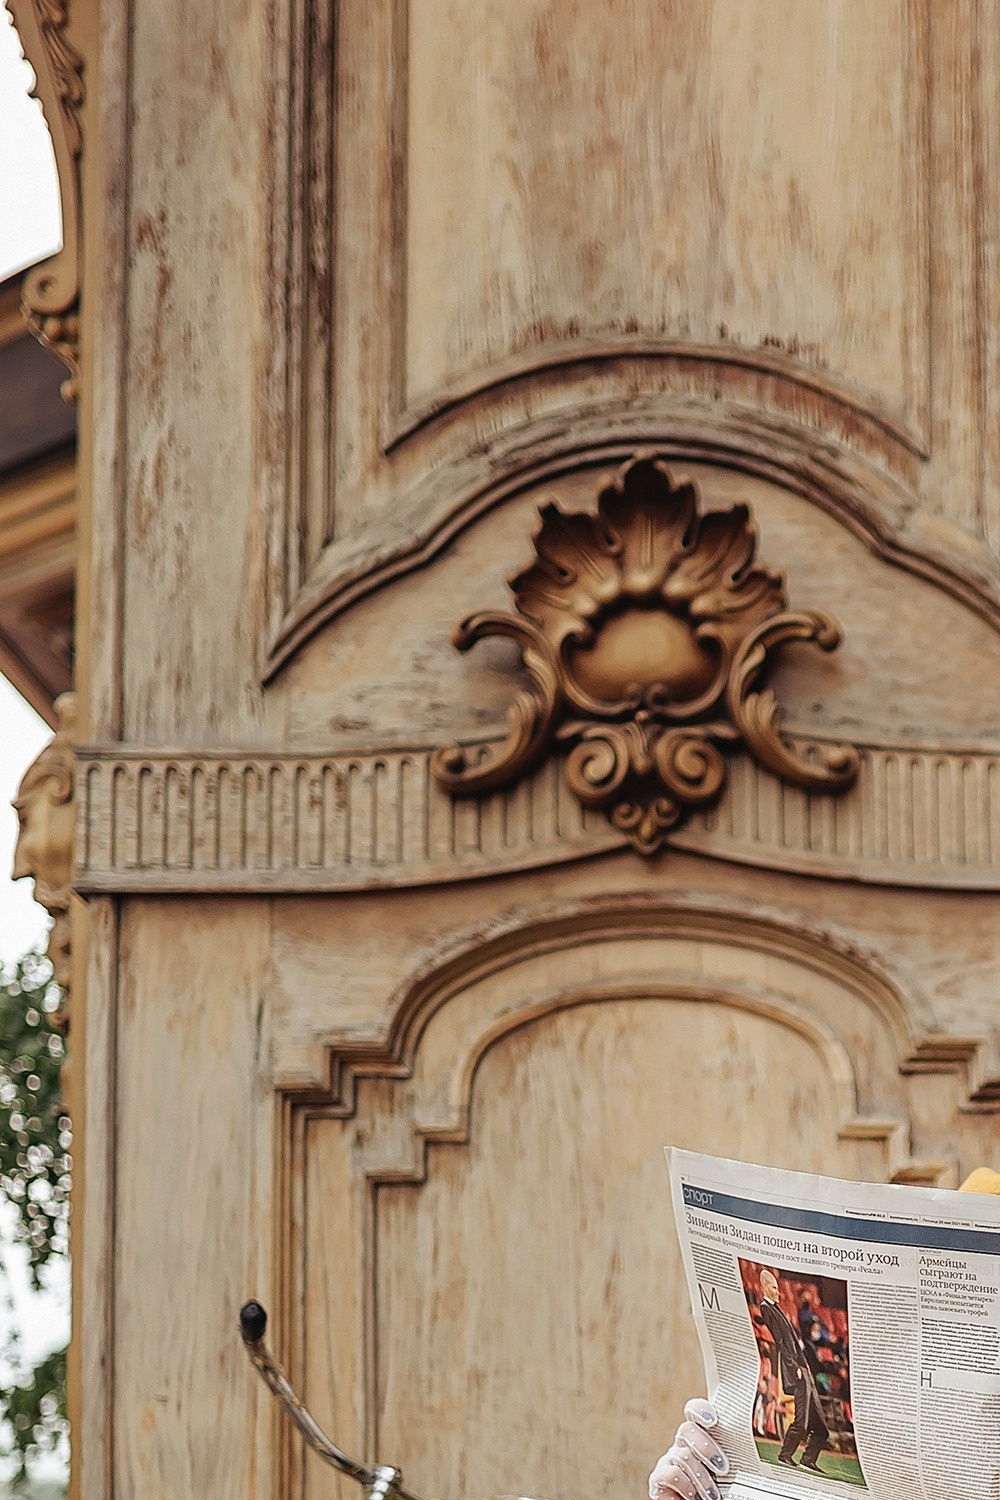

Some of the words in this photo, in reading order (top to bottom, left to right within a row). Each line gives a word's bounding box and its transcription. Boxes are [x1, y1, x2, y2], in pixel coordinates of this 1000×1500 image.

[684, 1187, 713, 1205] спорт
[686, 1212, 728, 1234] Зинедин
[729, 1224, 761, 1243] Зидан
[763, 1236, 800, 1251] пошел
[803, 1243, 818, 1254] на
[821, 1245, 864, 1261] второй
[866, 1253, 900, 1267] уход
[800, 1257, 830, 1267] главного
[831, 1262, 857, 1272] тренера
[919, 1256, 967, 1269] Армейцы
[920, 1268, 964, 1279] сыграют
[965, 1273, 977, 1281] на
[920, 1279, 998, 1294] подтверждение
[920, 1289, 937, 1297] ЦСКА
[967, 1309, 989, 1317] трофей
